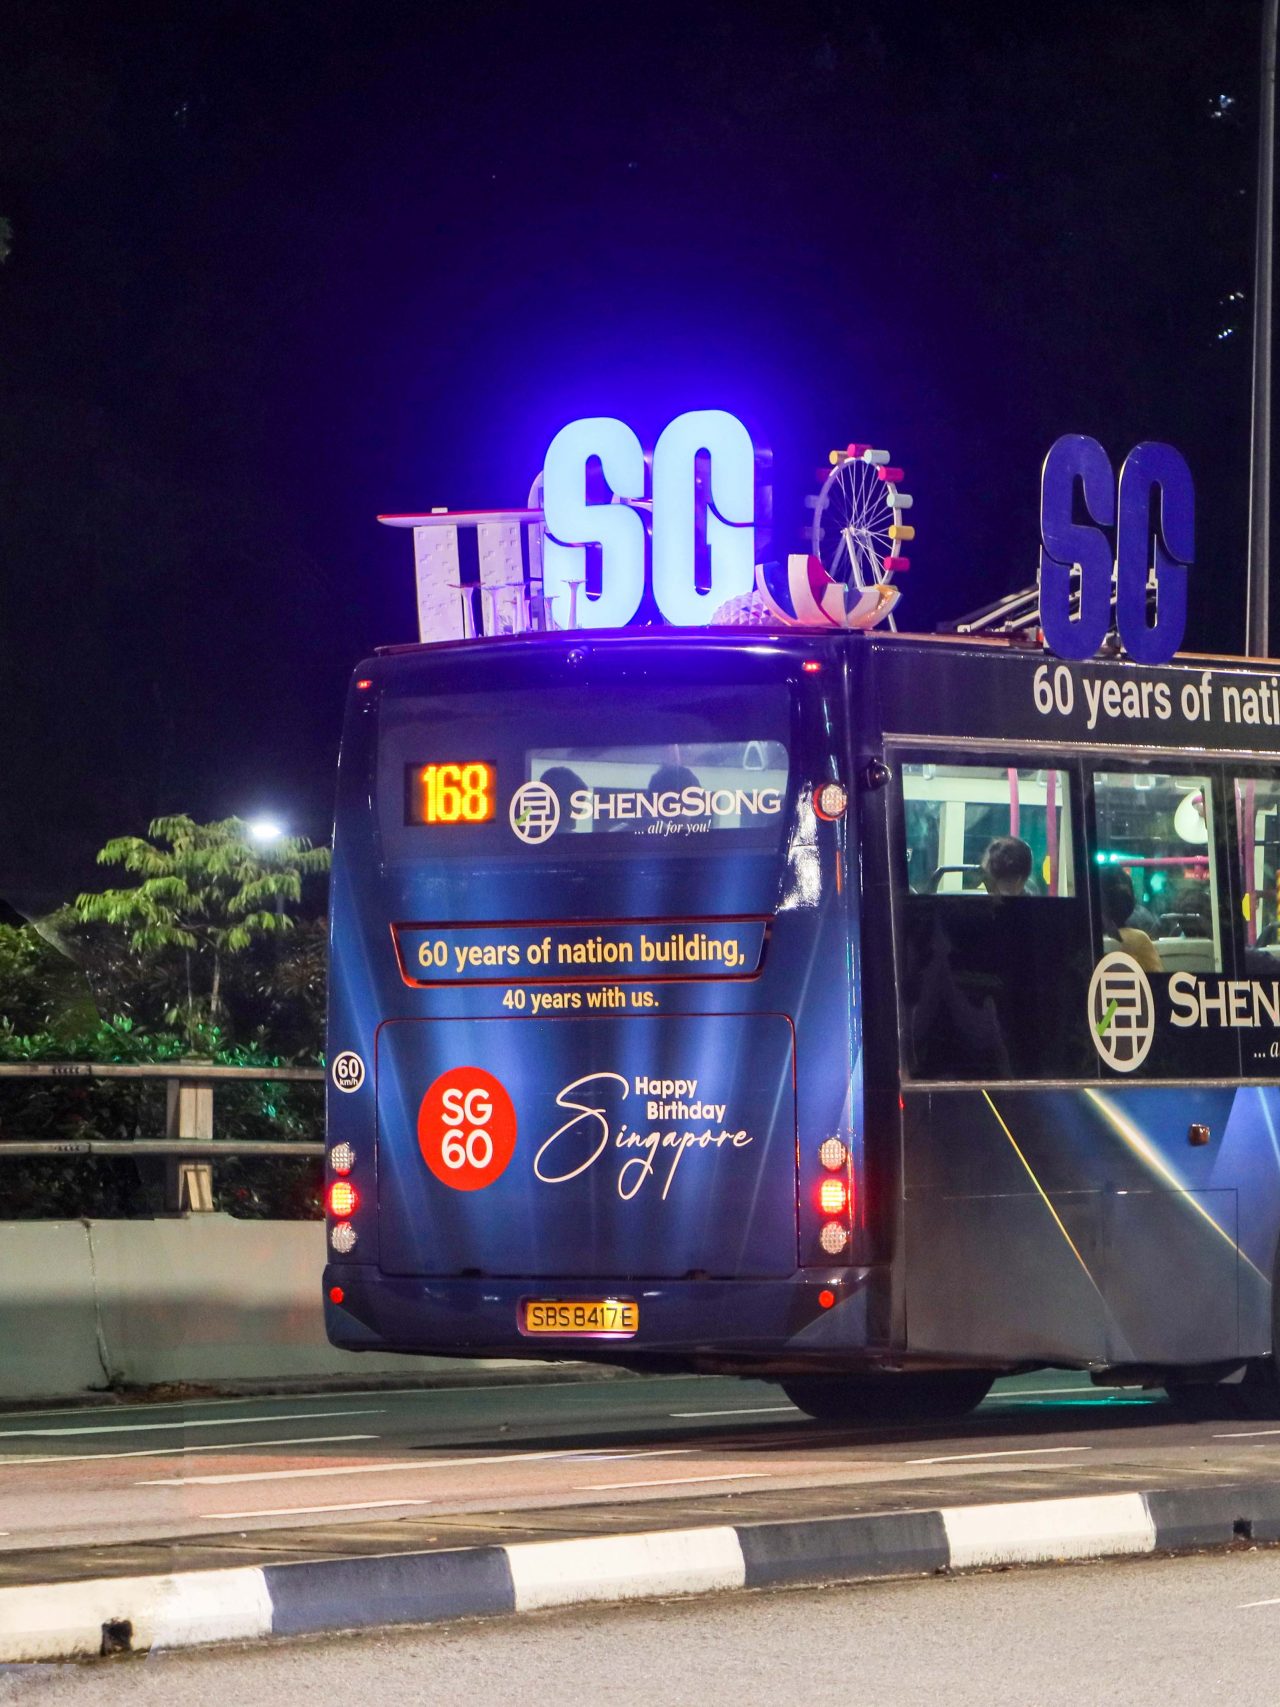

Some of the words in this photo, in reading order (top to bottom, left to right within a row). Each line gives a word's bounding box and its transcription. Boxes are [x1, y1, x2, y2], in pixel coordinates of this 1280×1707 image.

[543, 409, 755, 628] SG
[1039, 433, 1195, 664] SG
[1033, 664, 1073, 716] 60
[1083, 676, 1172, 730] years
[1181, 672, 1212, 722] of
[422, 763, 490, 822] 168
[647, 820, 664, 834] all
[664, 820, 684, 837] for
[685, 819, 712, 837] you!
[418, 940, 448, 967] 60
[454, 944, 520, 973] years
[526, 937, 552, 965] of
[558, 936, 634, 964] nation
[640, 934, 746, 967] building,
[502, 989, 526, 1010] 40
[530, 991, 582, 1014] years
[587, 987, 627, 1008] with
[631, 990, 660, 1008] us.
[338, 1058, 359, 1078] 60
[340, 1078, 358, 1086] km/h
[635, 1076, 698, 1099] Happy
[441, 1088, 494, 1126] SG
[647, 1100, 726, 1123] Birthday
[441, 1129, 494, 1170] 60
[534, 1072, 752, 1201] Singapore
